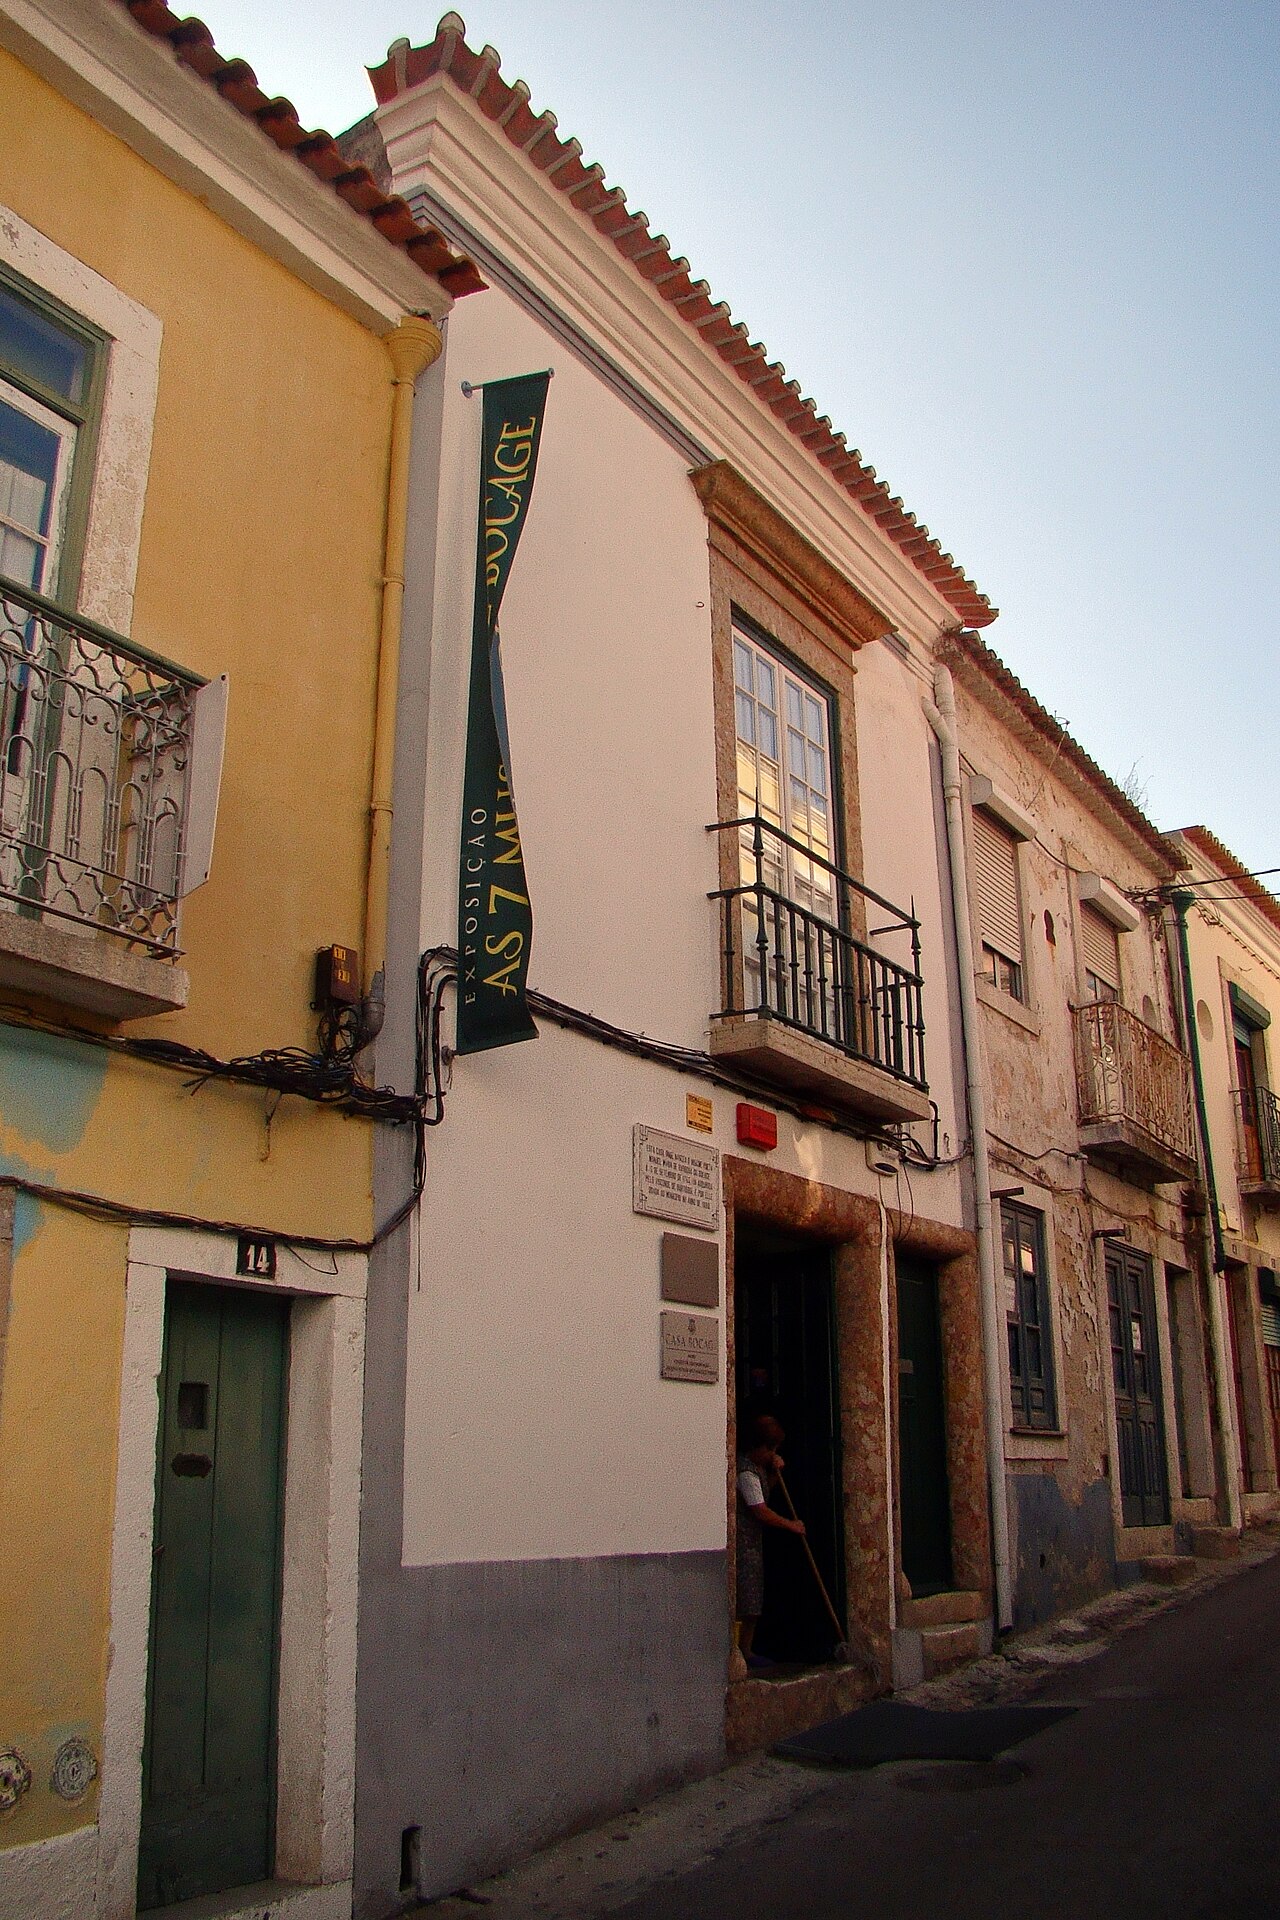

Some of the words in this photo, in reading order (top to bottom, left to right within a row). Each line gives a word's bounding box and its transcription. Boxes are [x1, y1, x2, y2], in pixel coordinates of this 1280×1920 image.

[489, 884, 530, 914] 7
[483, 930, 524, 997] AS
[247, 1245, 269, 1273] 14
